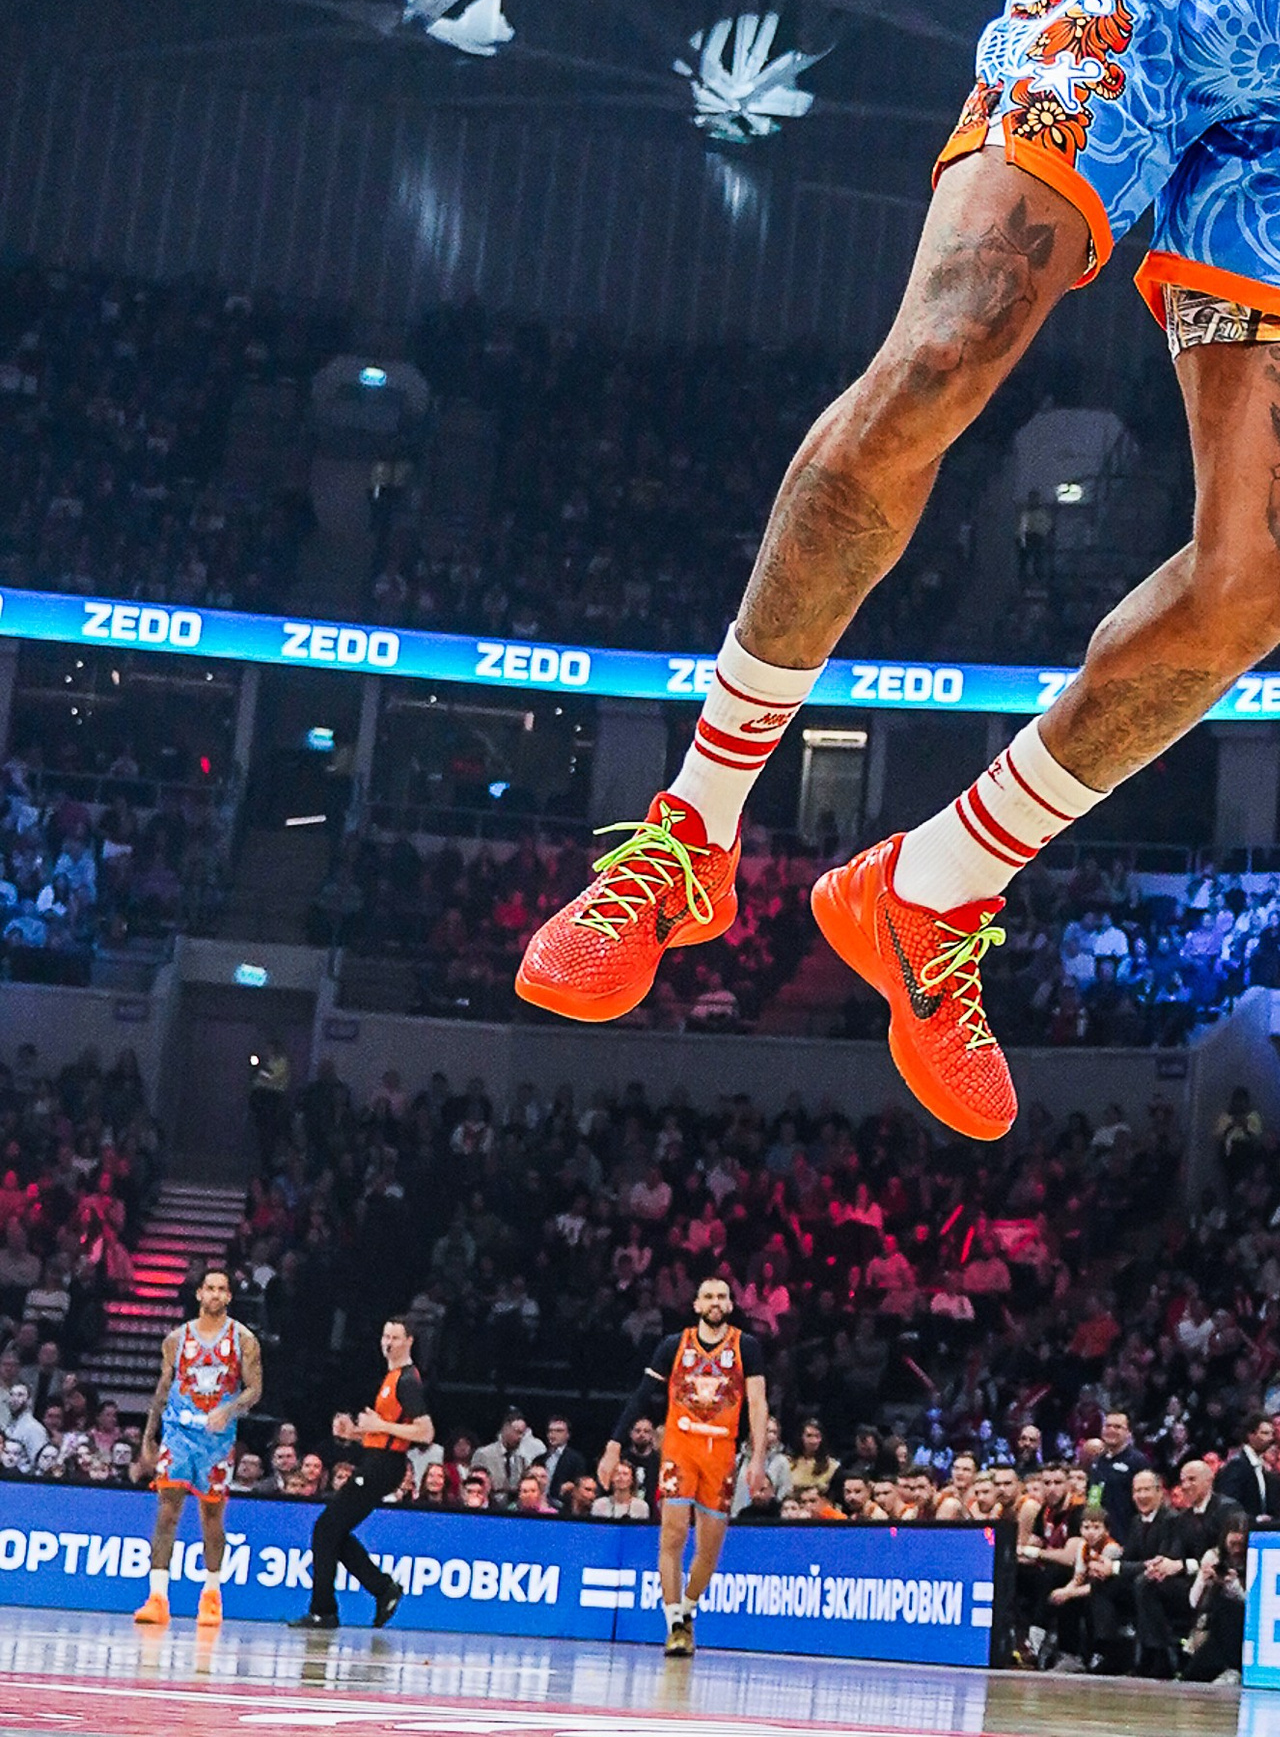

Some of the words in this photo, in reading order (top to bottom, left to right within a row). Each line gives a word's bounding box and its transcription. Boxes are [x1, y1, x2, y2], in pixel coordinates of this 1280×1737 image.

[82, 602, 202, 647] ZEDO
[281, 622, 400, 667] ZEDO
[475, 642, 591, 686] ZEDO
[850, 665, 964, 703] ZEDO
[822, 1576, 963, 1625] ЭКИПИРОВКИ
